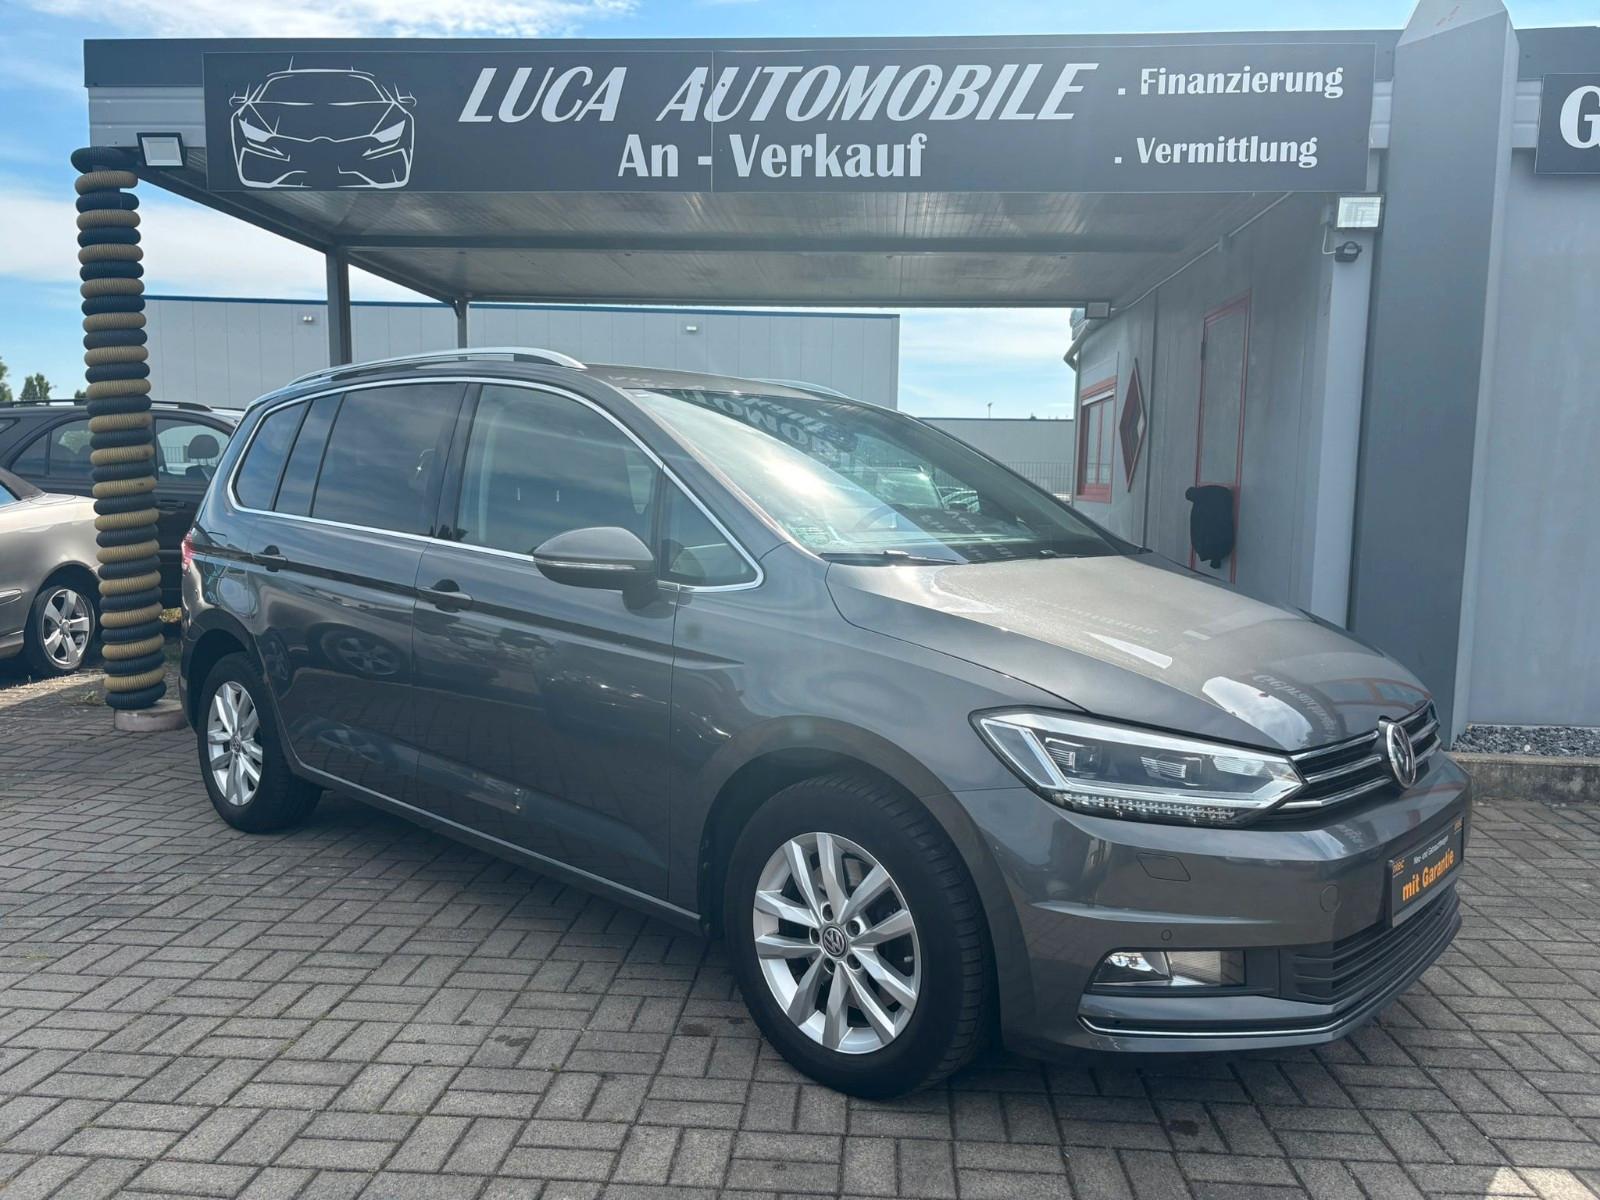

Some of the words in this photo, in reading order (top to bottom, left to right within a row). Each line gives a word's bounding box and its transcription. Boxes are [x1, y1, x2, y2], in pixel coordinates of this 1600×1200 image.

[458, 66, 628, 123] LUCA
[656, 63, 1099, 122] AUTOMOBILE
[1140, 66, 1344, 99] Finanzierung
[617, 134, 679, 178] An
[729, 132, 928, 178] Verkauf
[1137, 135, 1318, 168] Vermittlung
[1402, 873, 1420, 902] mit
[1422, 847, 1455, 888] Garantie
